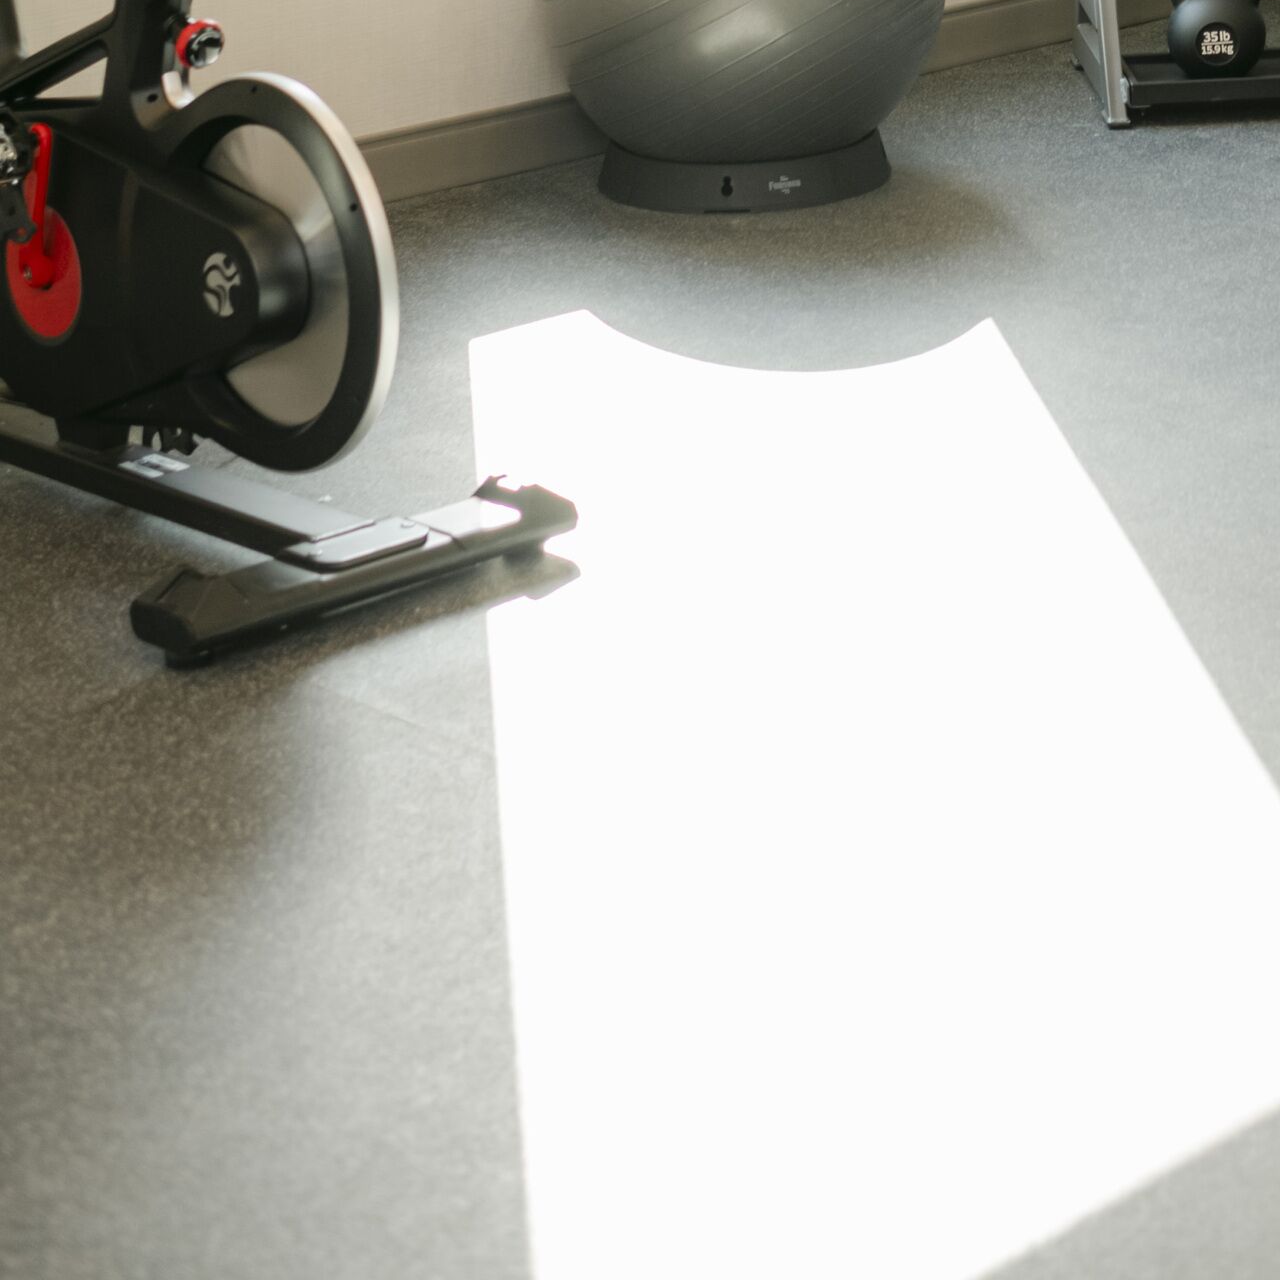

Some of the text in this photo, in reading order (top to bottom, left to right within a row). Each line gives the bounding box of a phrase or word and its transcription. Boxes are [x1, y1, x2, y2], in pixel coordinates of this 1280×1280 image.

[1202, 30, 1231, 42] 35 lb
[1201, 44, 1234, 55] 15.9 kg
